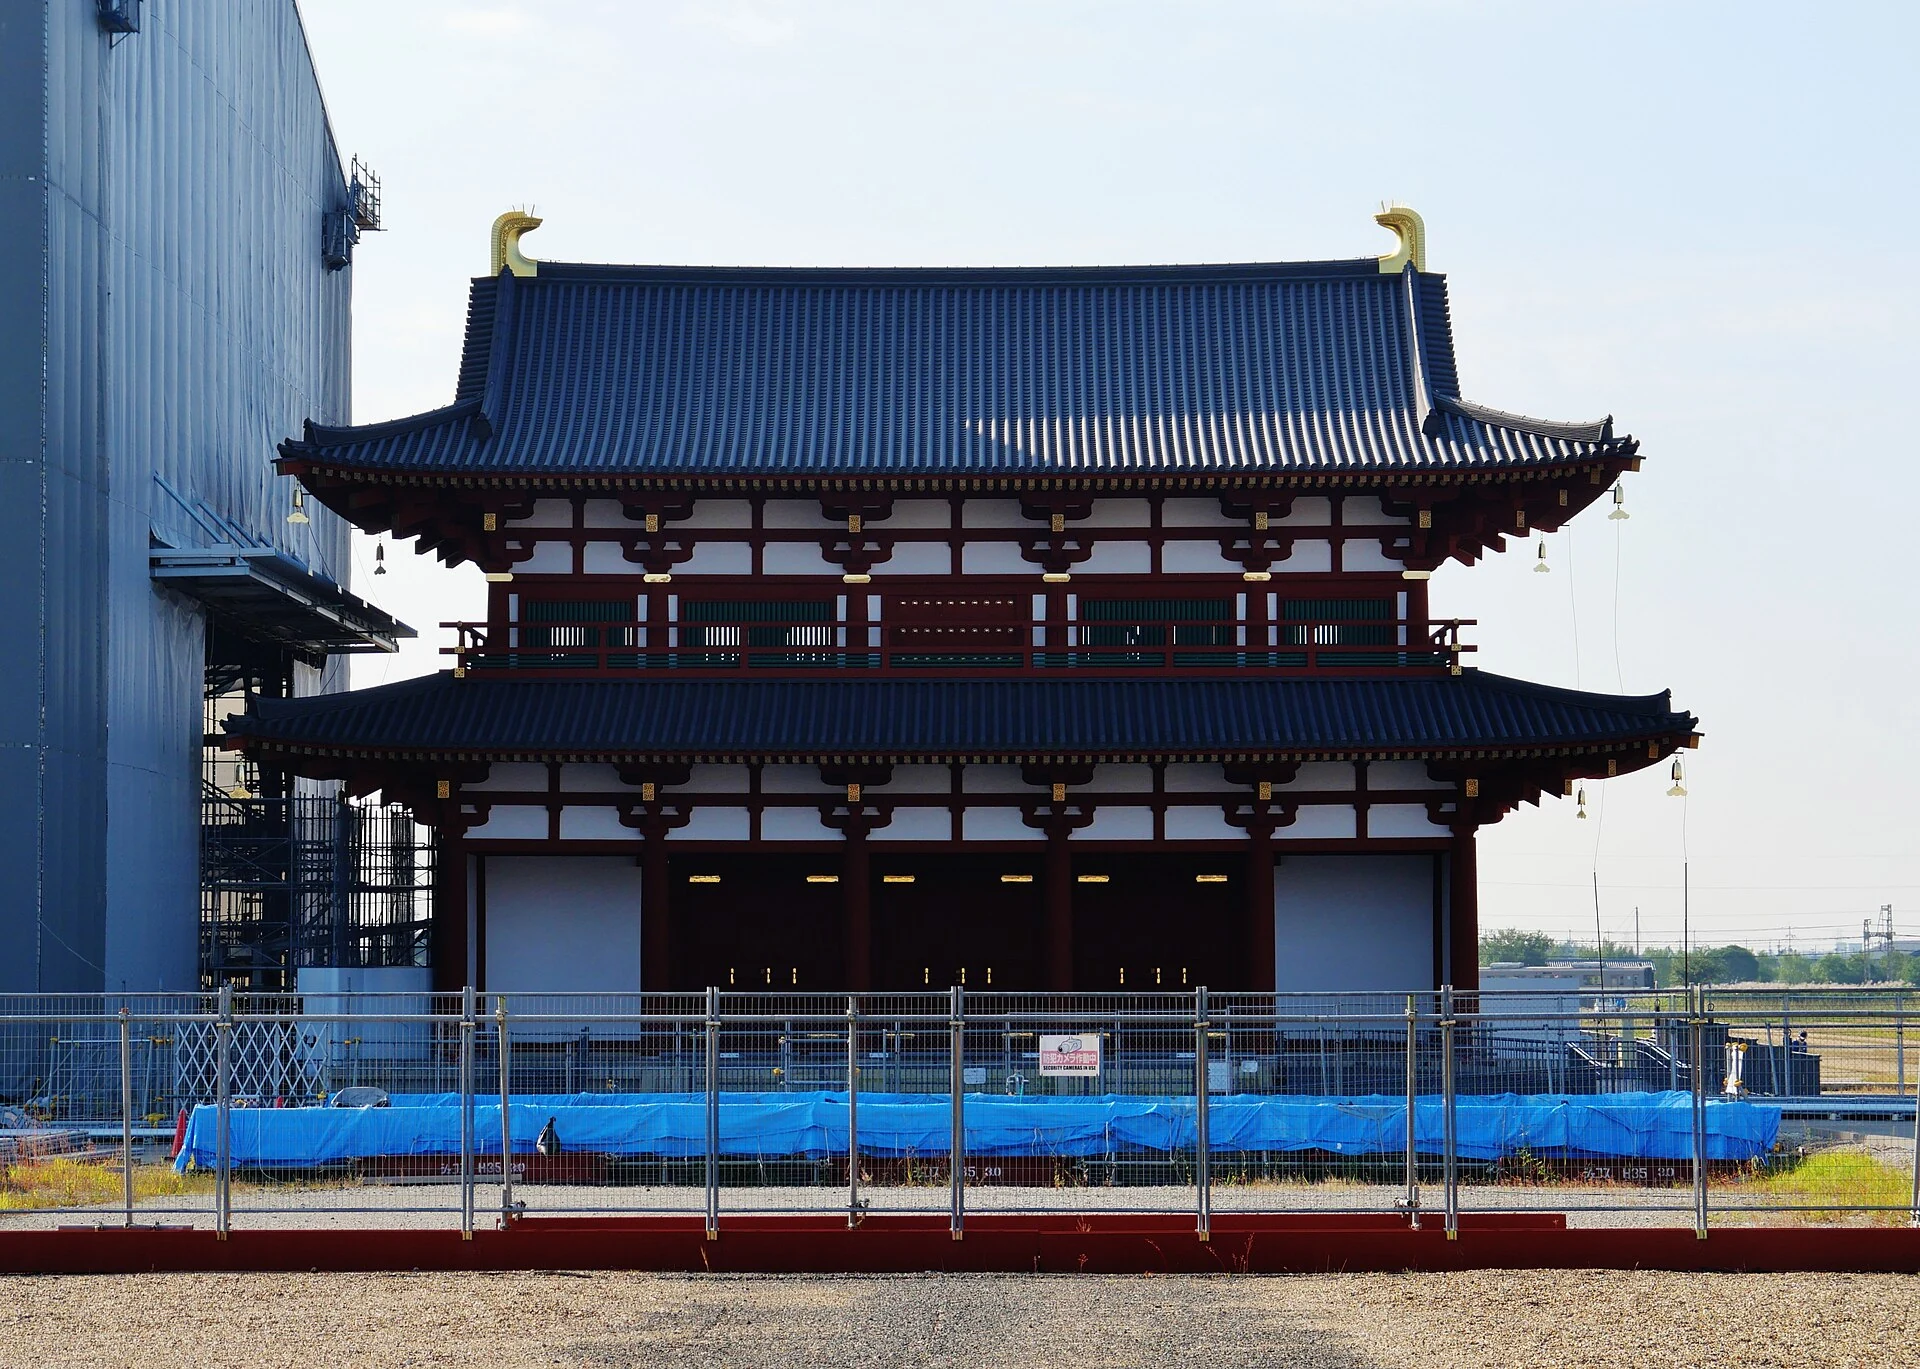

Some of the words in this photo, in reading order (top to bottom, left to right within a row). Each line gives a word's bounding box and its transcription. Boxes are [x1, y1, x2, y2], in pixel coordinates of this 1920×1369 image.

[1043, 1053, 1097, 1064] 防犯カメラ作動中
